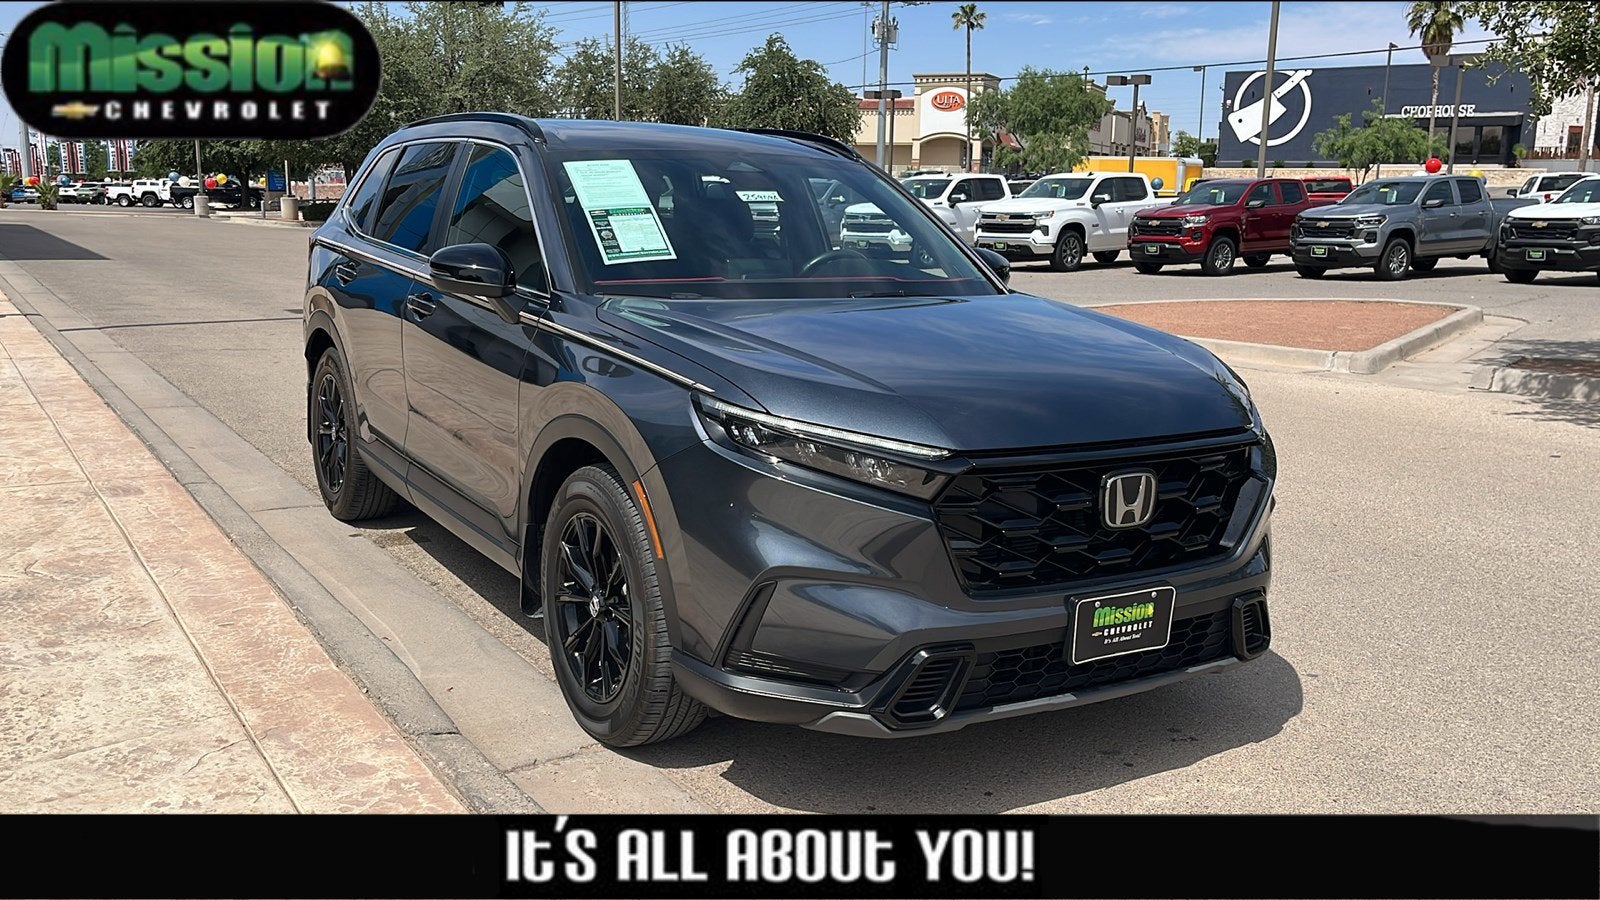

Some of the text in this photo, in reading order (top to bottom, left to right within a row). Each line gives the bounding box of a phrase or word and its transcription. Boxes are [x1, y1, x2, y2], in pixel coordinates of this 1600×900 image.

[937, 95, 960, 104] ULTA
[1116, 475, 1146, 525] H
[1093, 602, 1155, 628] Mission
[1103, 620, 1153, 636] CHEVROLET
[626, 619, 644, 703] KINERG
